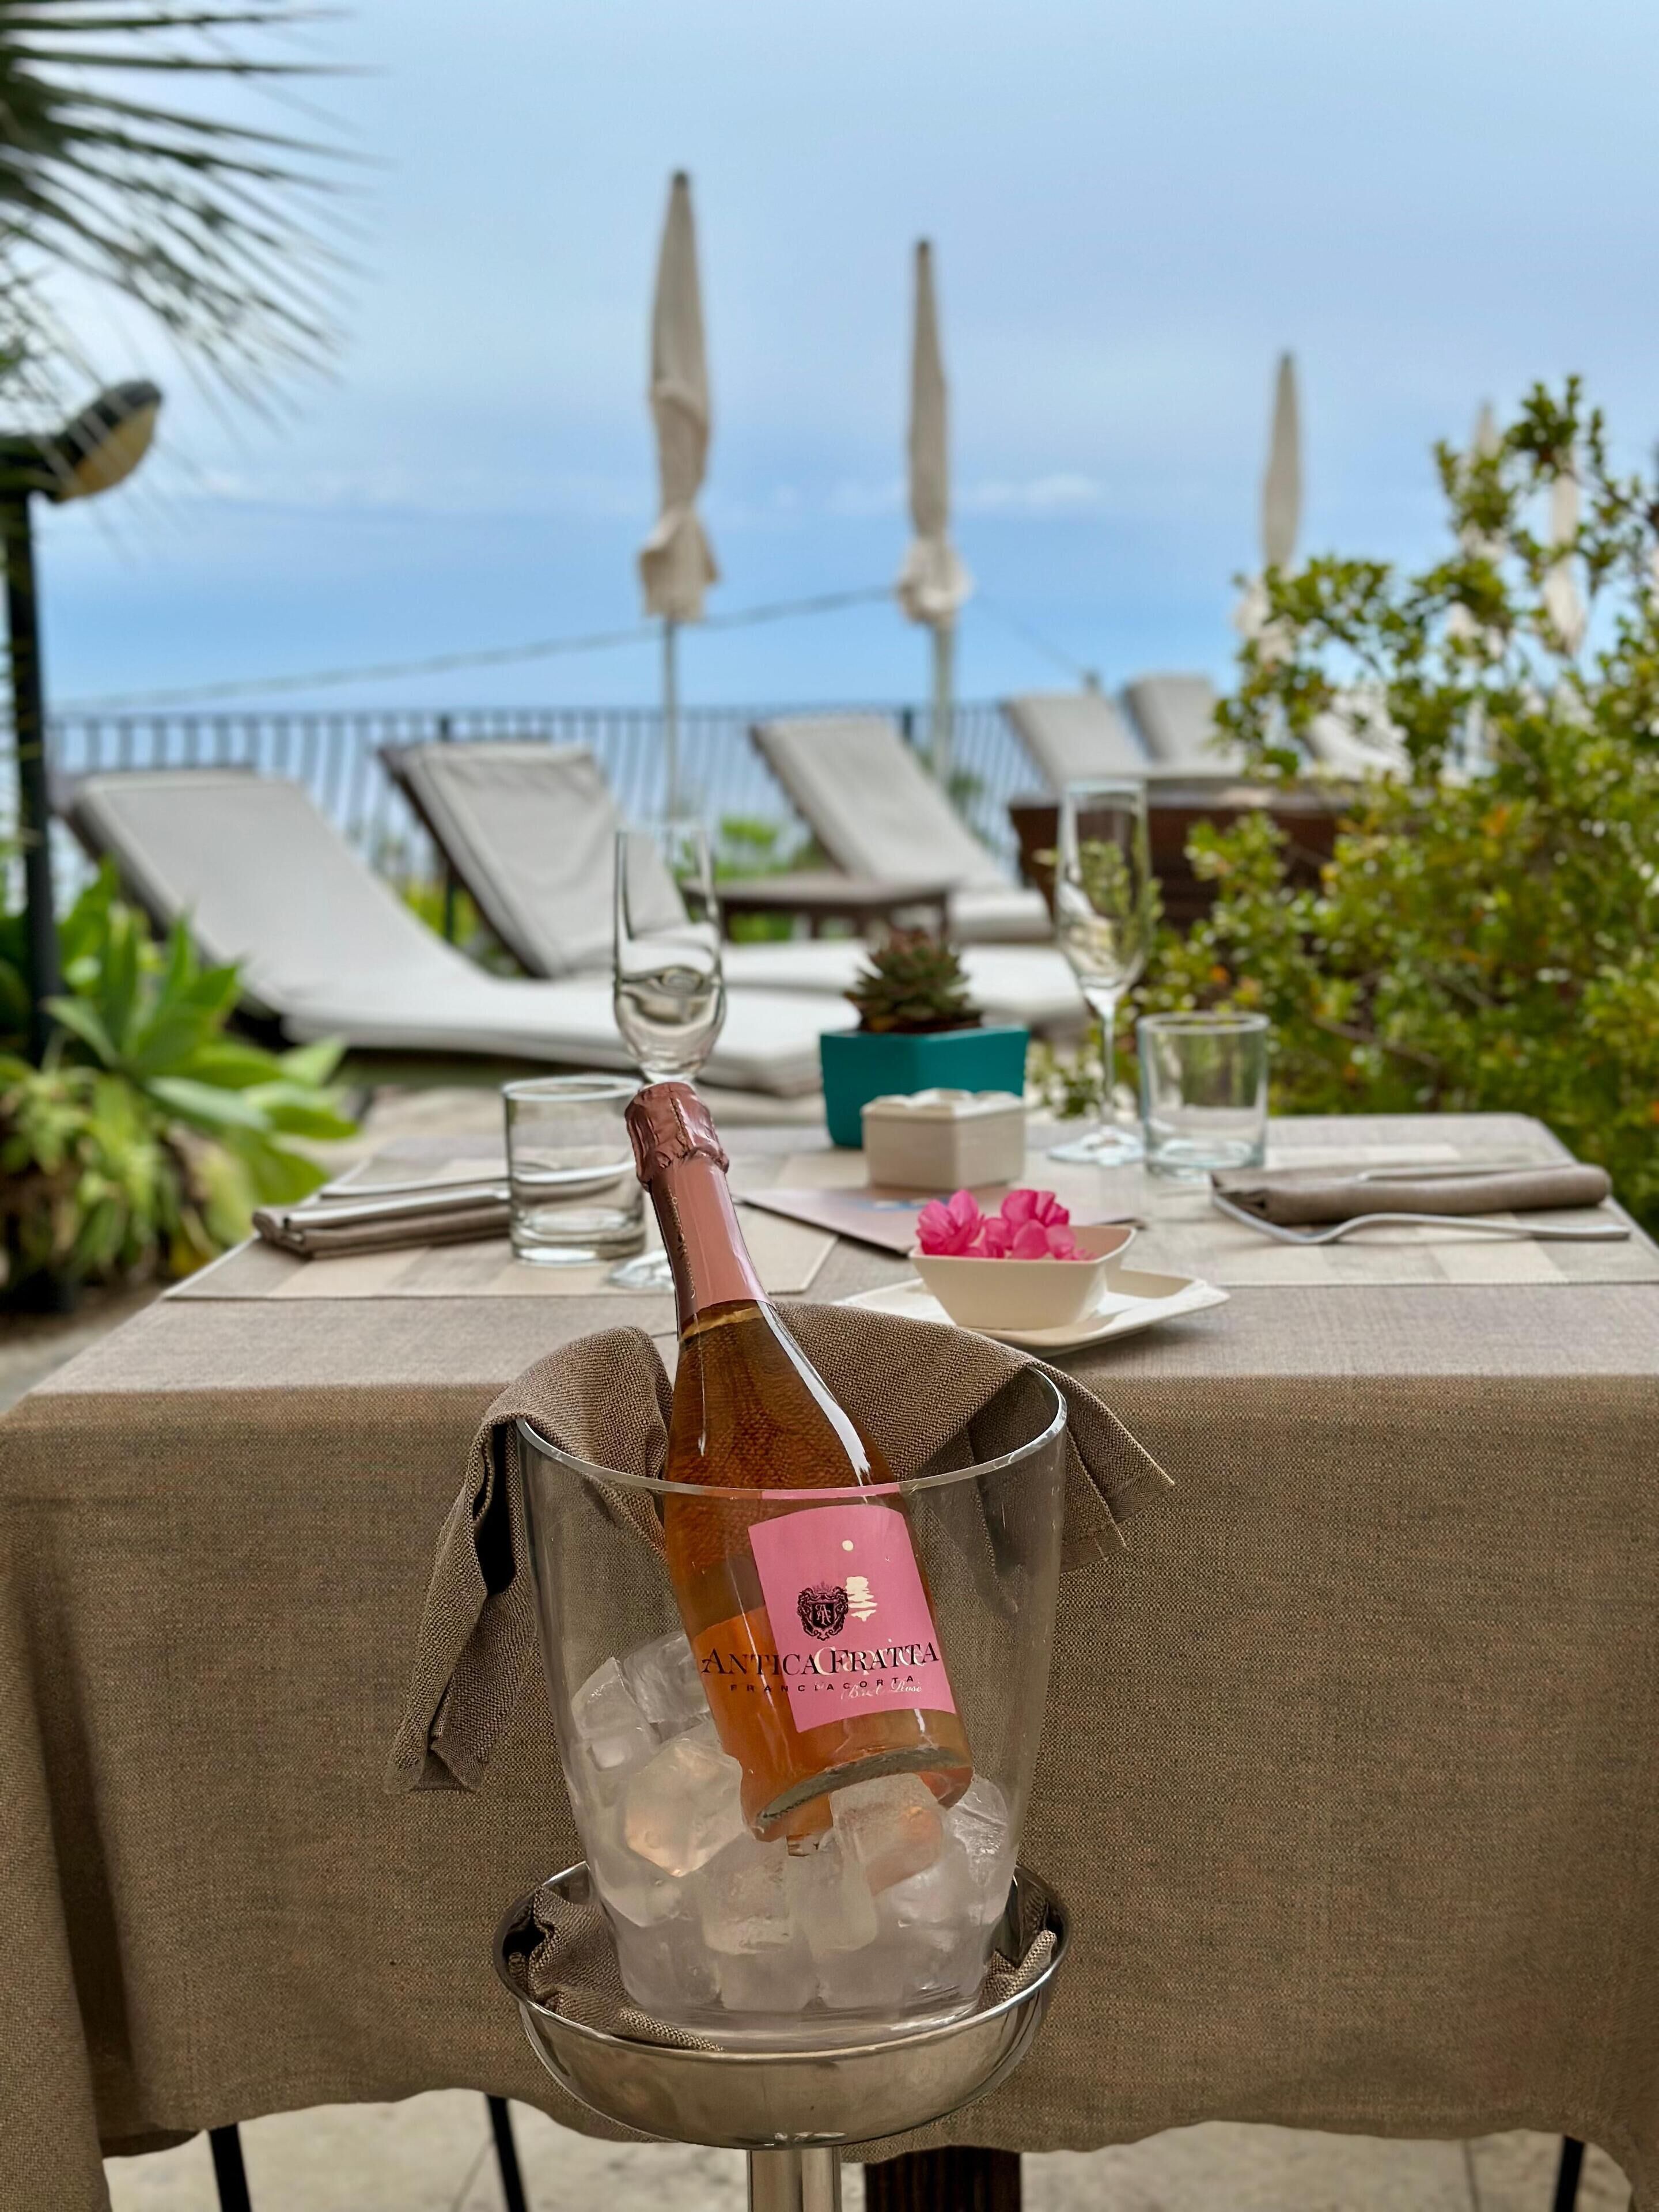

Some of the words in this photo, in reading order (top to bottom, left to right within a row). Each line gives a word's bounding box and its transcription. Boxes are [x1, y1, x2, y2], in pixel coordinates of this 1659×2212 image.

[702, 1648, 820, 1675] ANTICA
[830, 1642, 940, 1673] FRATTA
[730, 1675, 914, 1692] FRANCIACORTA
